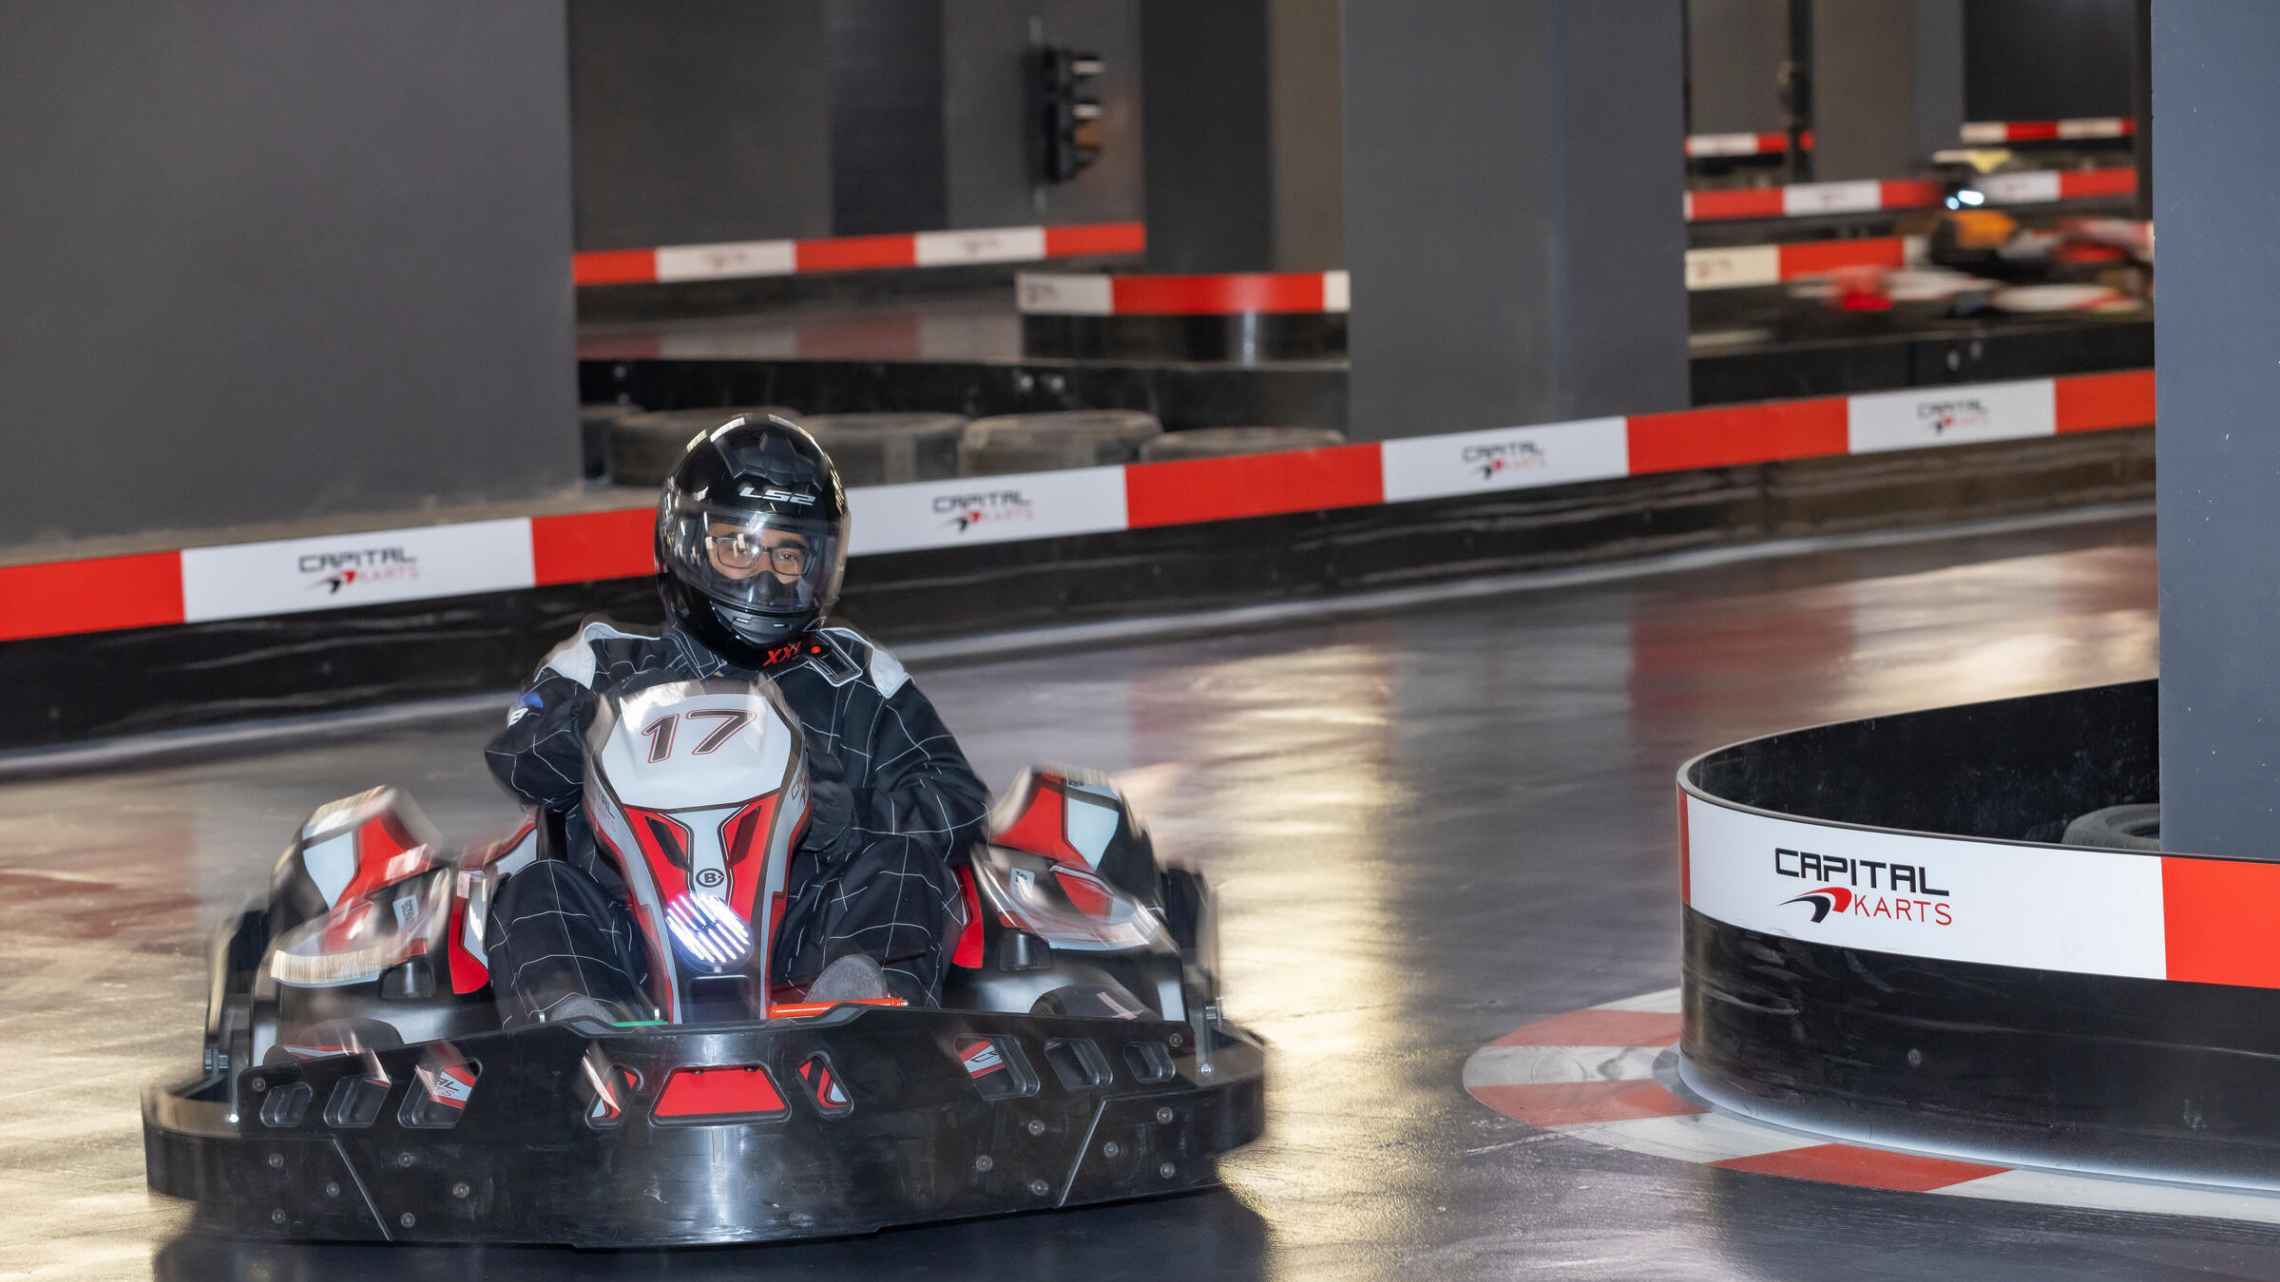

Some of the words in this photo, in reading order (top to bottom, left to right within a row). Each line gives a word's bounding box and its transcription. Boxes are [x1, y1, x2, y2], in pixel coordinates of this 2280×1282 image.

[739, 486, 816, 506] LS2
[931, 490, 1031, 514] CAPITAL
[299, 546, 417, 573] CAPITAL
[641, 708, 757, 764] 17
[1775, 847, 1949, 897] CAPITAL
[1854, 894, 1952, 926] KARTS
